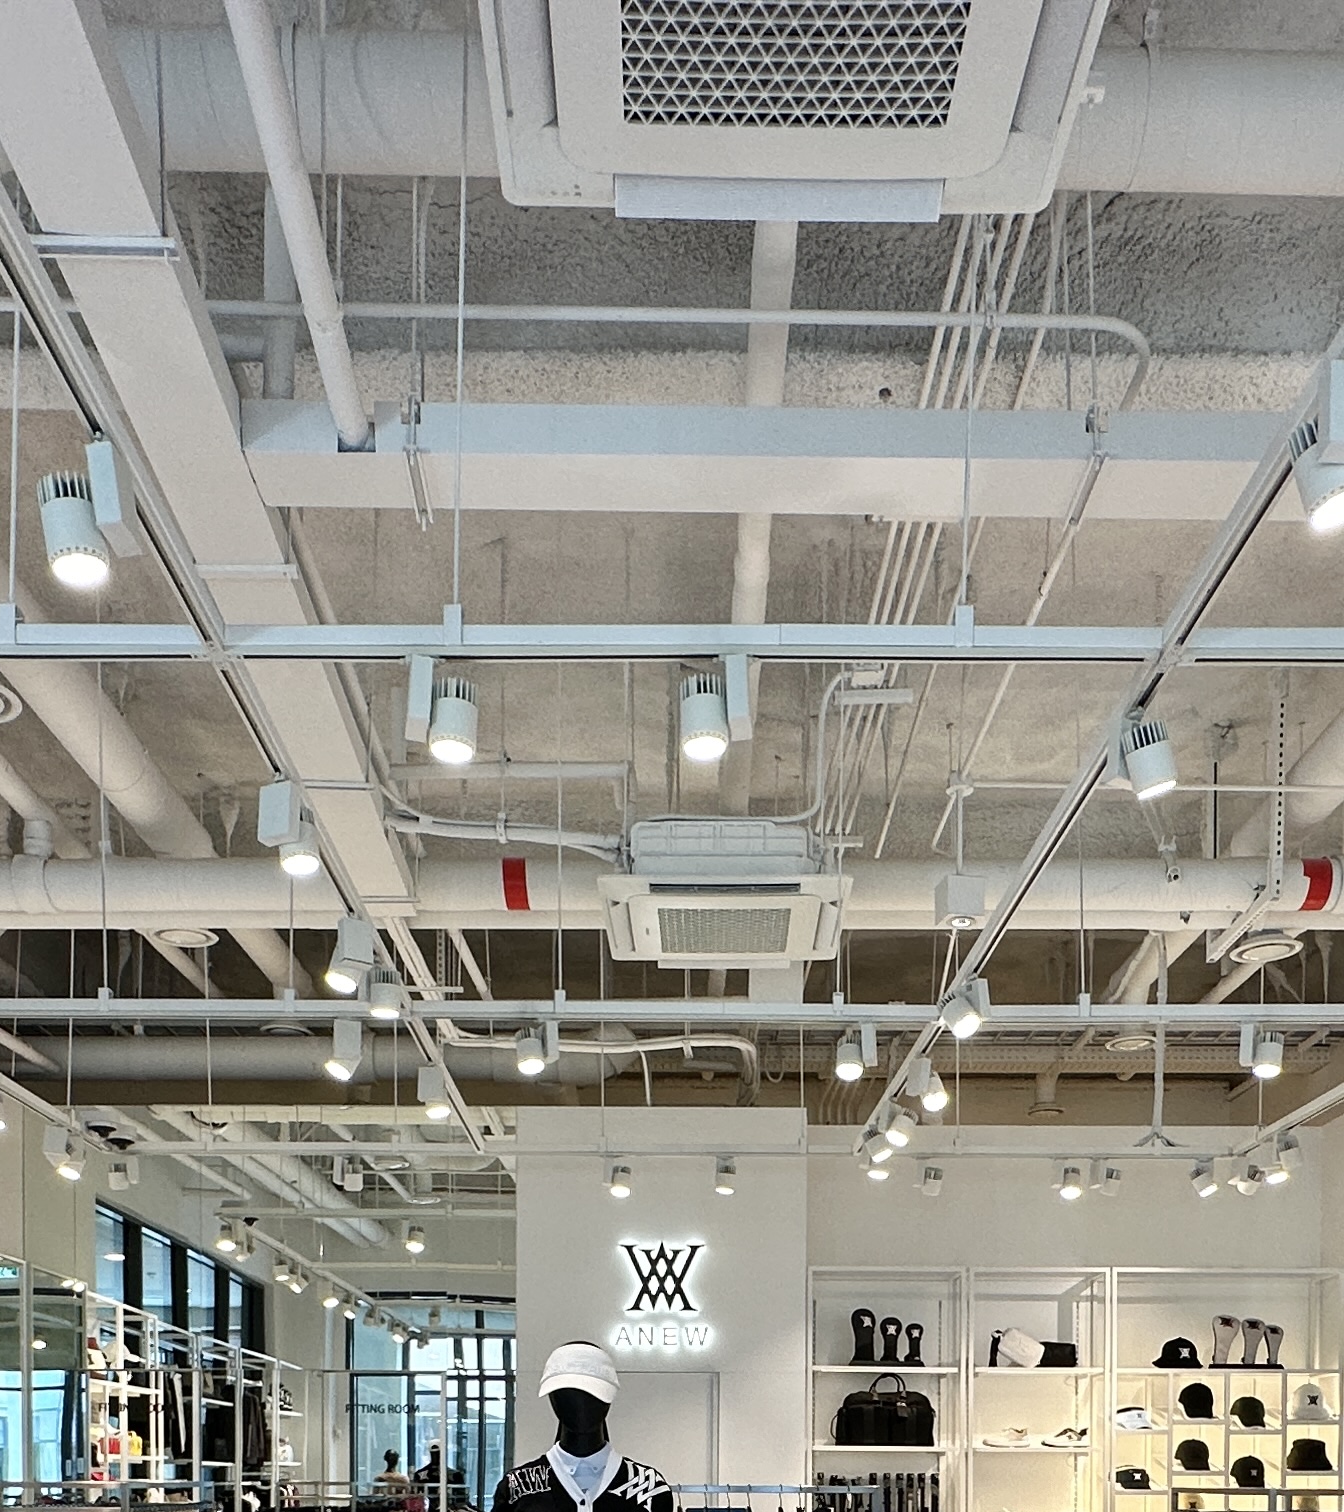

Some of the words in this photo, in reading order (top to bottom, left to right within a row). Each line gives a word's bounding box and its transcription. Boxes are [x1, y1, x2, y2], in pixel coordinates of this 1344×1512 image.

[615, 1326, 709, 1346] ANEW
[345, 1403, 385, 1414] FTTING
[388, 1403, 420, 1414] ROOM
